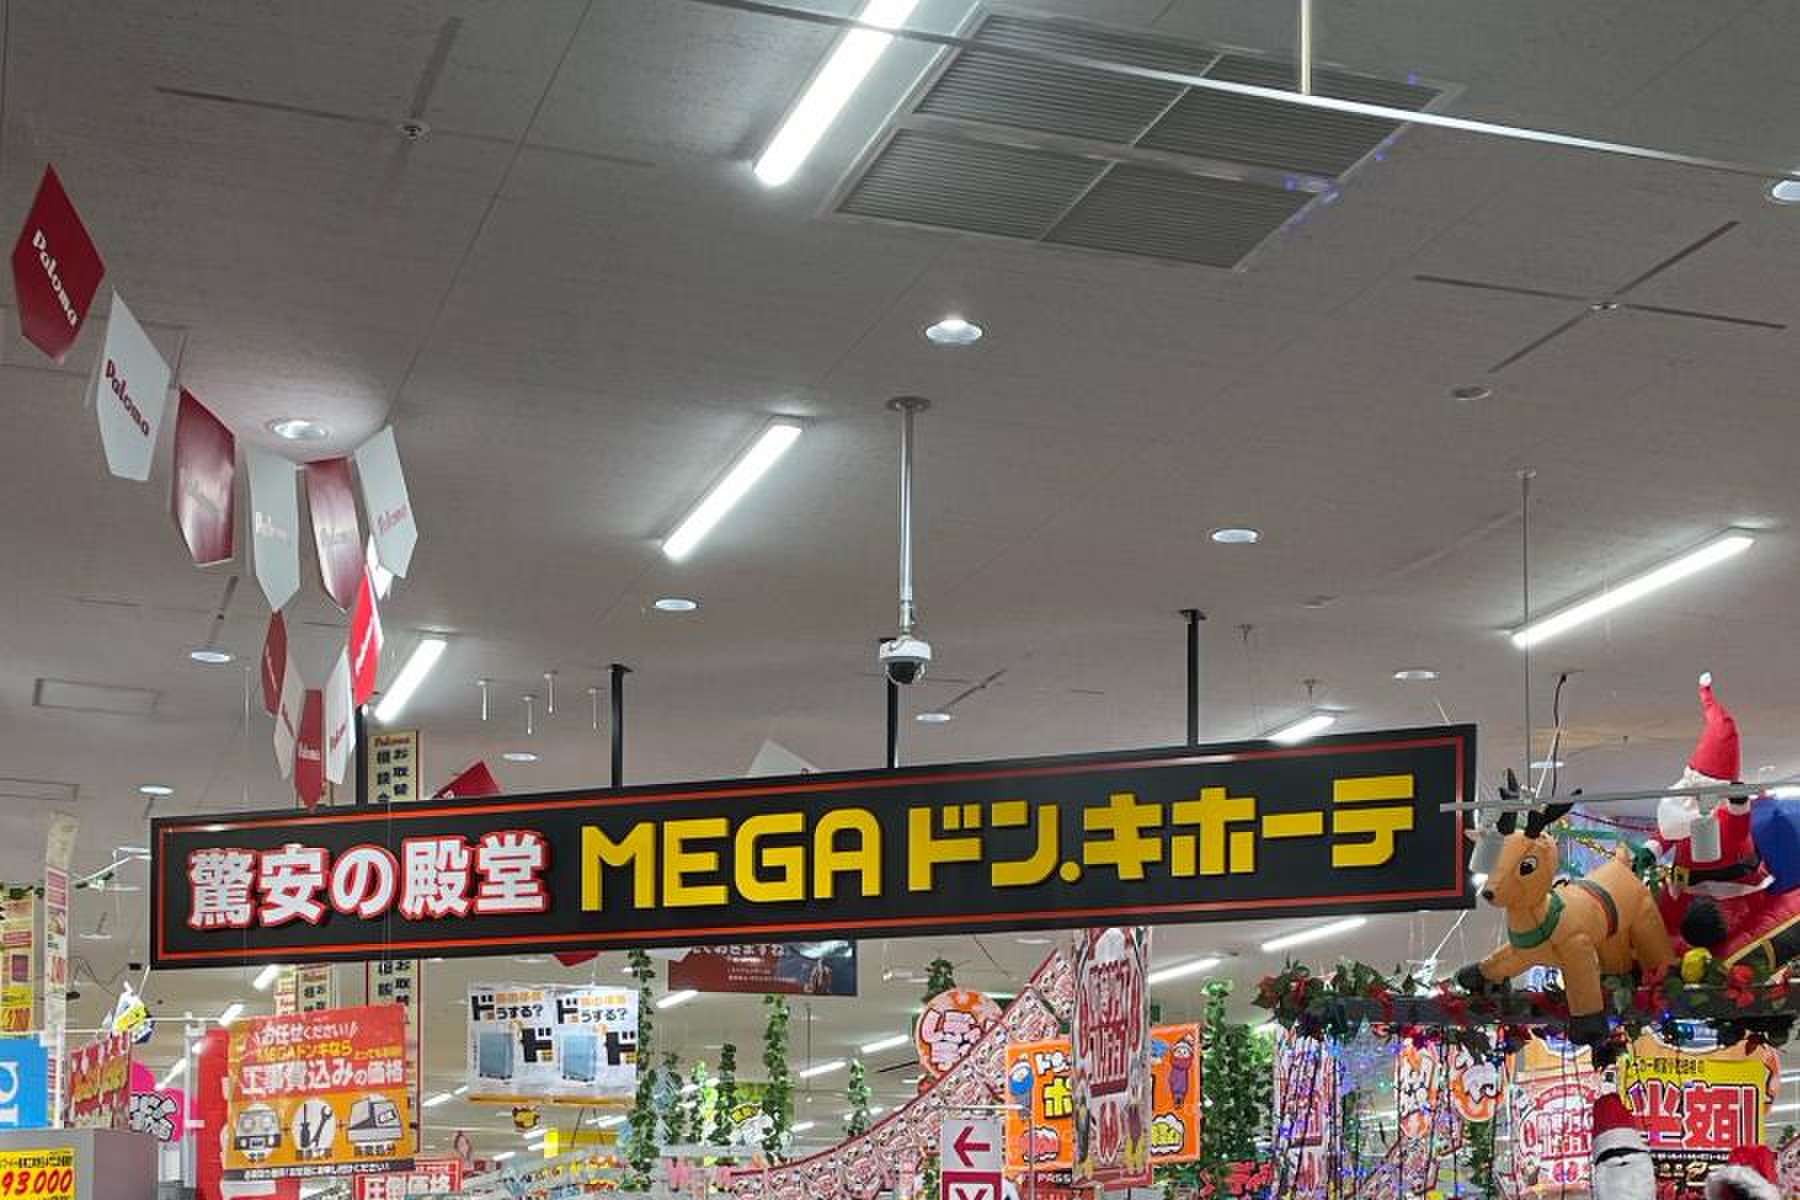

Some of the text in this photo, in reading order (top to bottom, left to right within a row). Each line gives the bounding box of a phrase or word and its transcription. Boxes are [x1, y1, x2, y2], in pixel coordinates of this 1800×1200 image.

[32, 229, 78, 326] Paloma
[105, 359, 150, 437] Paloma
[188, 832, 548, 929] 驚安の殿堂
[581, 808, 882, 912] MEGA
